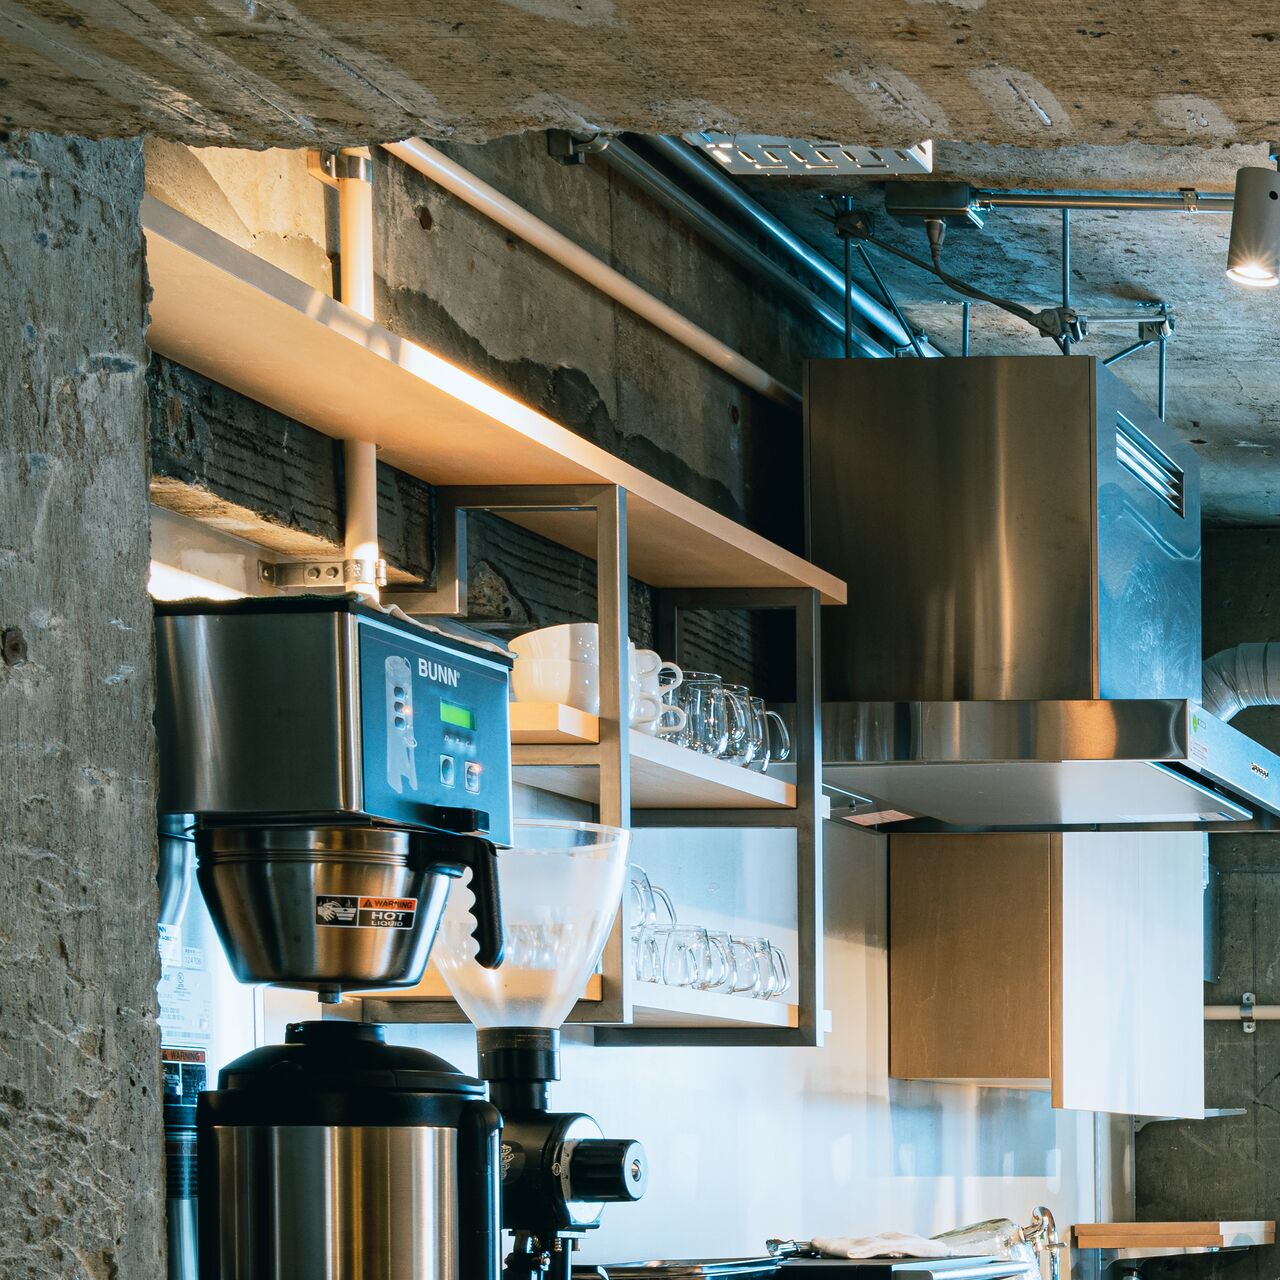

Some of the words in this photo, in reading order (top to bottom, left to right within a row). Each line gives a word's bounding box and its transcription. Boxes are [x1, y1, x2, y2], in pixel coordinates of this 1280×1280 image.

[418, 658, 458, 688] BUNN
[374, 900, 413, 909] WARNING
[371, 911, 406, 921] HOT
